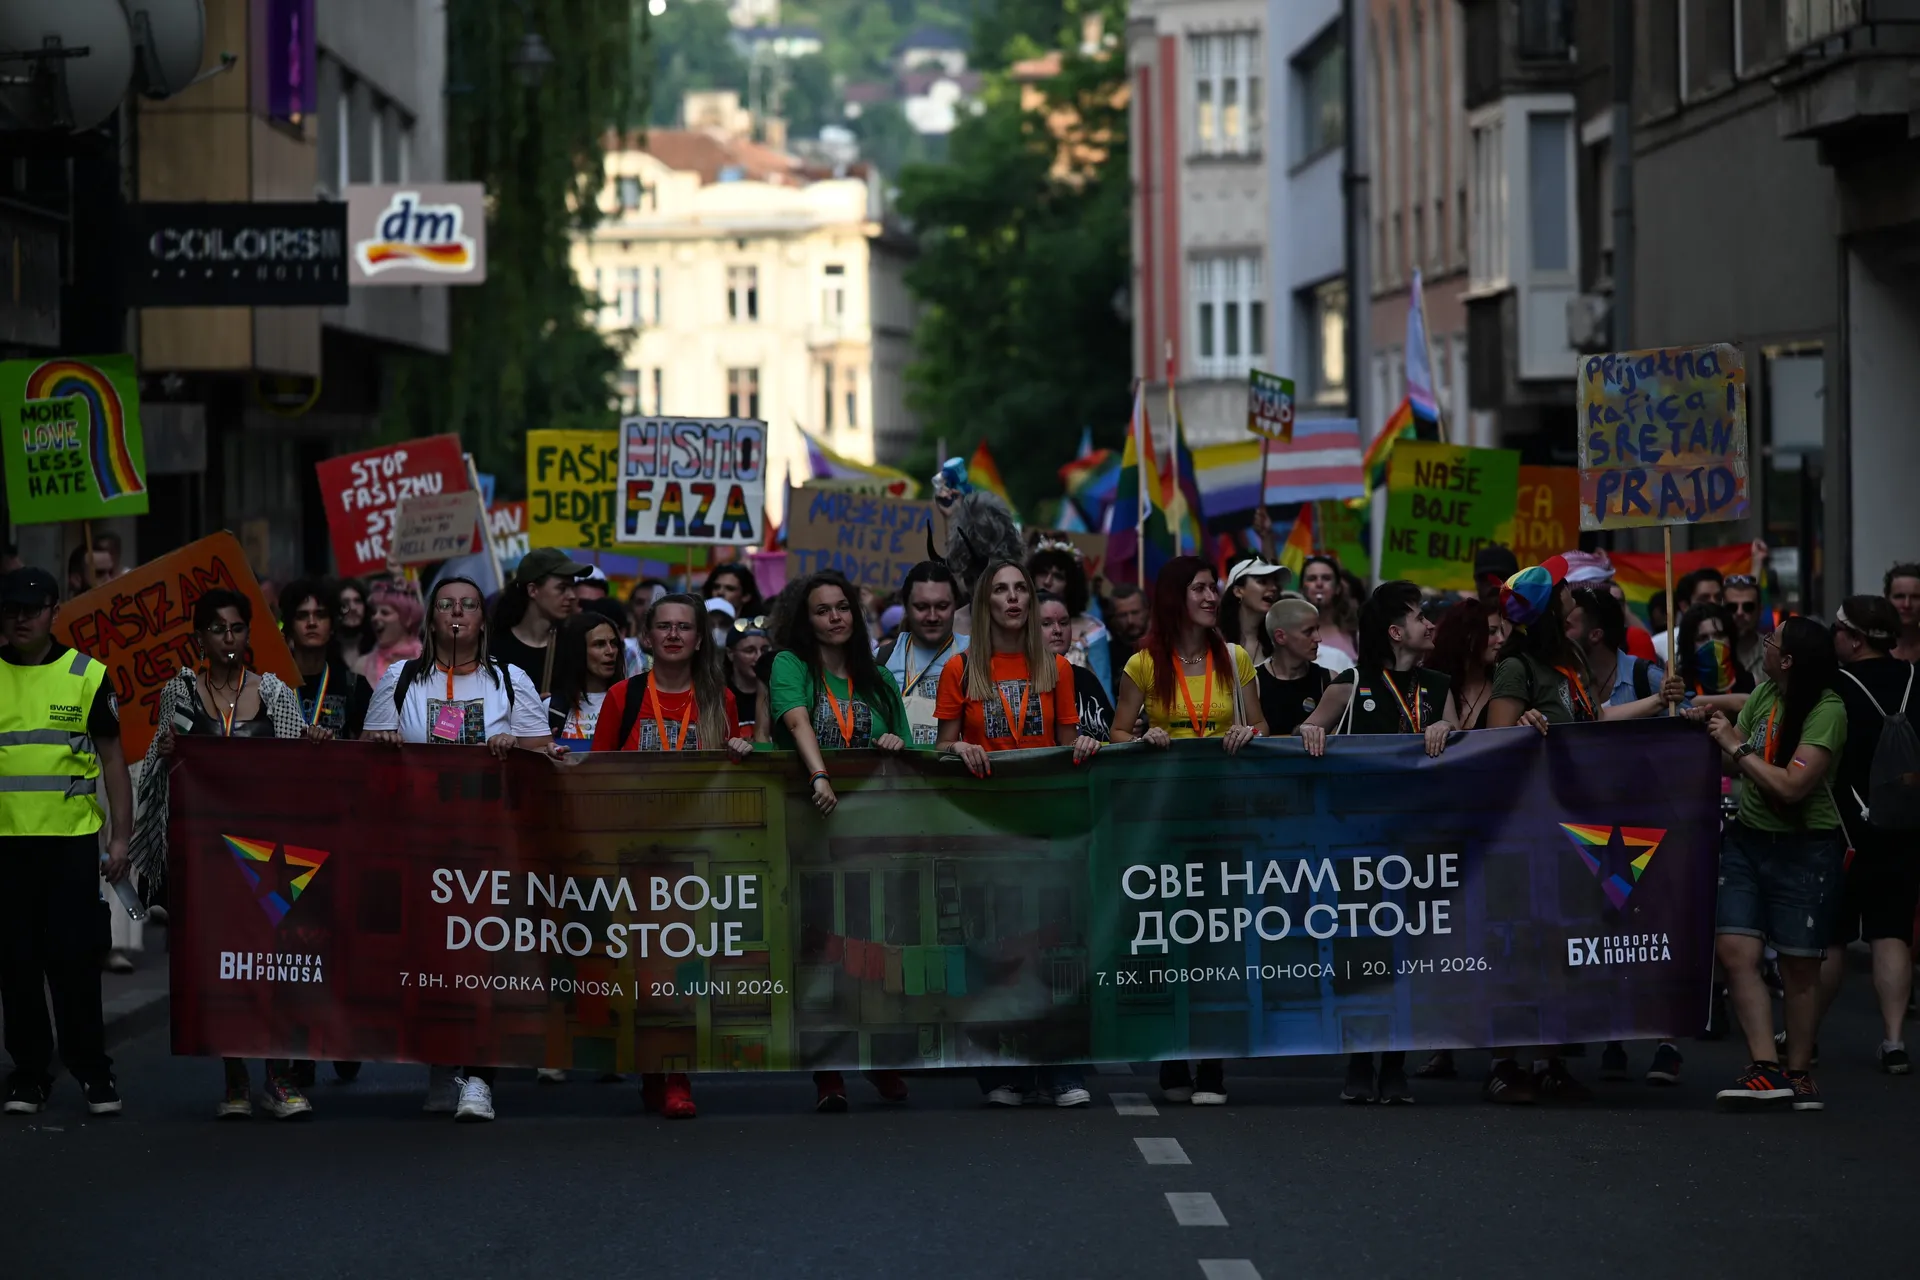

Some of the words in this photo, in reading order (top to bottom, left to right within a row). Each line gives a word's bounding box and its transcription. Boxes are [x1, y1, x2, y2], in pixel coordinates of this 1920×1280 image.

[382, 201, 456, 242] dm
[150, 227, 320, 261] COLORS
[20, 402, 76, 423] MORE
[23, 420, 81, 453] LOVE
[625, 422, 763, 481] NISMO
[1589, 418, 1734, 467] SRETAN
[28, 452, 83, 473] LESS
[351, 450, 408, 487] STOP
[538, 444, 618, 484] FAŠIS
[1415, 457, 1482, 494] NAŠE
[29, 471, 87, 498] HATE
[1596, 466, 1737, 524] PRAJD
[532, 488, 617, 524] JEDIT
[625, 480, 754, 538] FAZA
[1412, 494, 1472, 526] BOJE
[579, 523, 612, 548] SE
[1390, 528, 1419, 555] NE
[793, 547, 918, 588] TRADICIJ
[69, 556, 239, 658] FAŠIZAM
[50, 714, 83, 723] SECURITY
[431, 868, 511, 905] SVE
[527, 871, 638, 912] NAM
[650, 874, 758, 911] BOJE
[1122, 863, 1205, 900] СВЕ
[1221, 858, 1341, 896] НАМ
[1353, 853, 1459, 893] БОЈЕ
[446, 915, 593, 957] DOBRO
[605, 921, 744, 959] STOJE
[1131, 903, 1291, 955] ДОБРО
[1304, 899, 1452, 939] СТОЈЕ
[220, 951, 253, 980] BH
[256, 953, 322, 966] POVORKA
[1568, 937, 1601, 966] БХ
[1603, 933, 1669, 947] ПОВОРКА
[1604, 945, 1671, 964] ПОНОСА
[256, 965, 323, 983] PONOSA
[399, 972, 412, 987] 7.
[418, 973, 448, 988] BH.
[455, 974, 545, 991] POVORKA
[550, 977, 624, 997] PONOSA
[650, 982, 679, 997] 20.
[684, 981, 731, 996] JUNI
[737, 980, 789, 995] 2026.
[1097, 971, 1109, 986] 7.
[1116, 970, 1143, 985] БХ.
[1149, 967, 1240, 984] ПОВОРКА
[1246, 963, 1336, 980] ПОНОСА
[1362, 961, 1391, 976] 20.
[1396, 959, 1434, 975] ЈУН
[1440, 956, 1492, 973] 2026.
